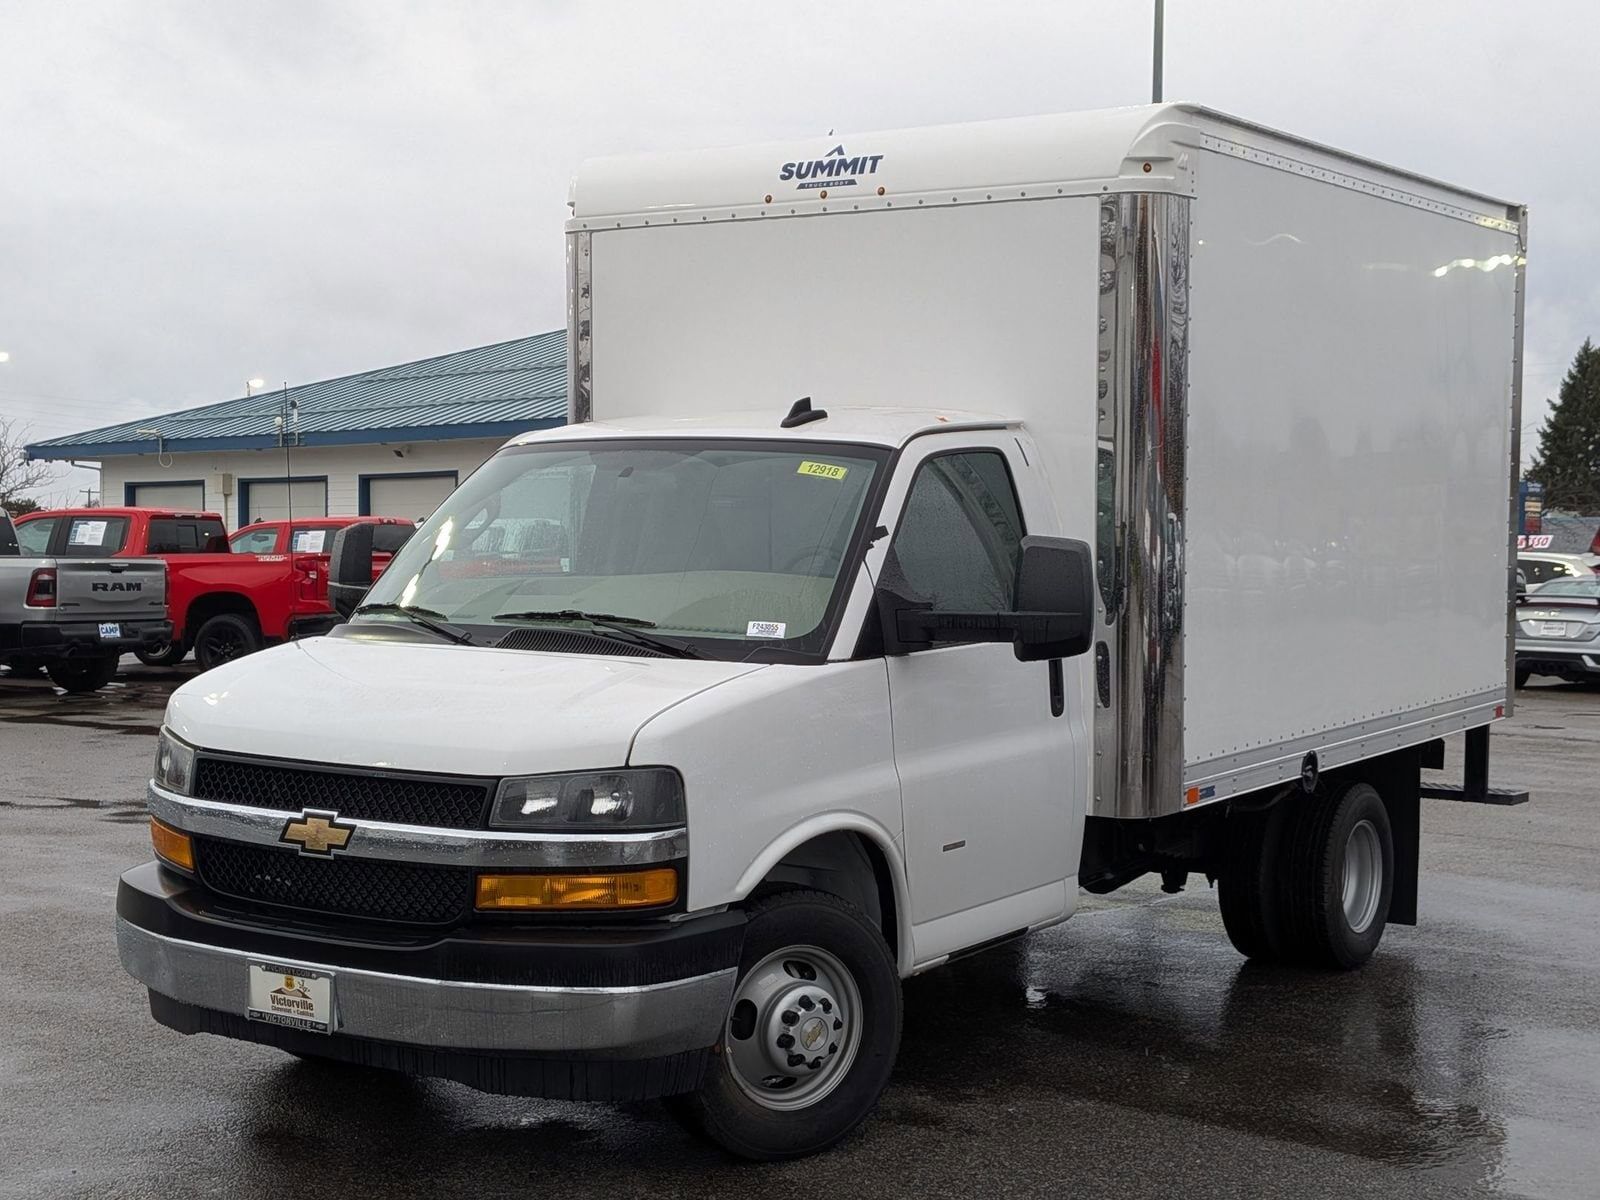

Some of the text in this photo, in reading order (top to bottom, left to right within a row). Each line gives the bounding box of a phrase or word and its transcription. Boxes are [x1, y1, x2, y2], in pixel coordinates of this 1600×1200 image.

[780, 155, 884, 180] SUMMIT
[807, 464, 839, 477] 12918
[92, 582, 142, 592] RAM
[270, 994, 314, 1011] Victorville
